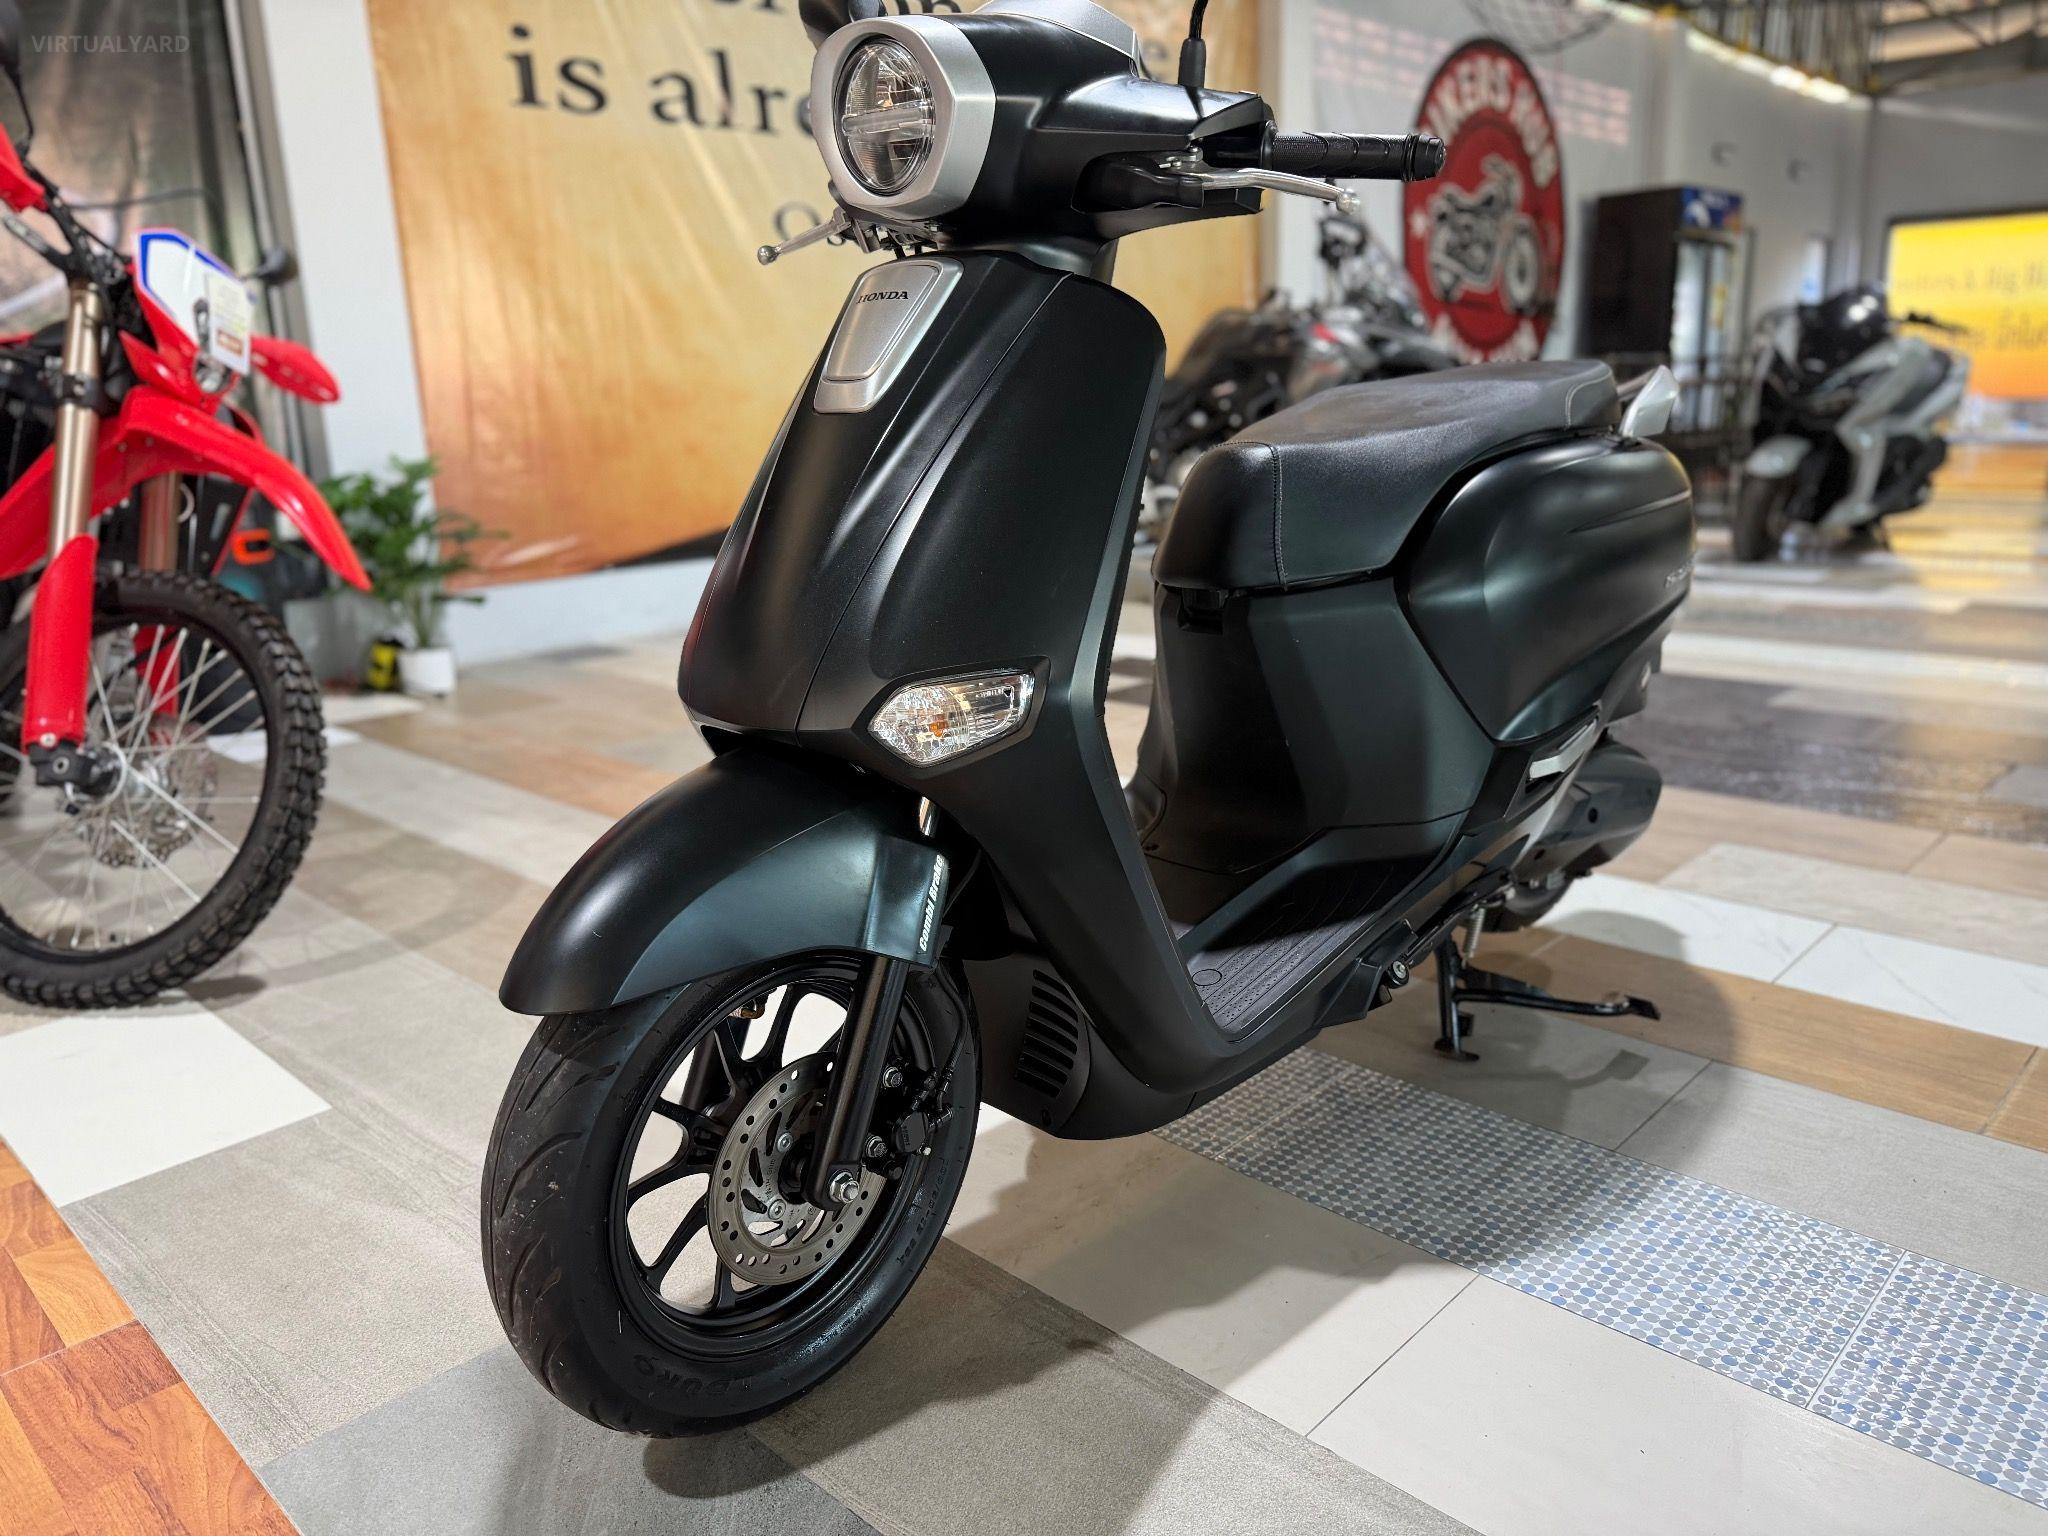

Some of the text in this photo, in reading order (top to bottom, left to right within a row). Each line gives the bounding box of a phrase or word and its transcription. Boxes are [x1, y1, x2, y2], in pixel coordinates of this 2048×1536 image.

[507, 24, 608, 115] is
[856, 291, 909, 305] HONDA
[919, 854, 945, 952] Combi Brake
